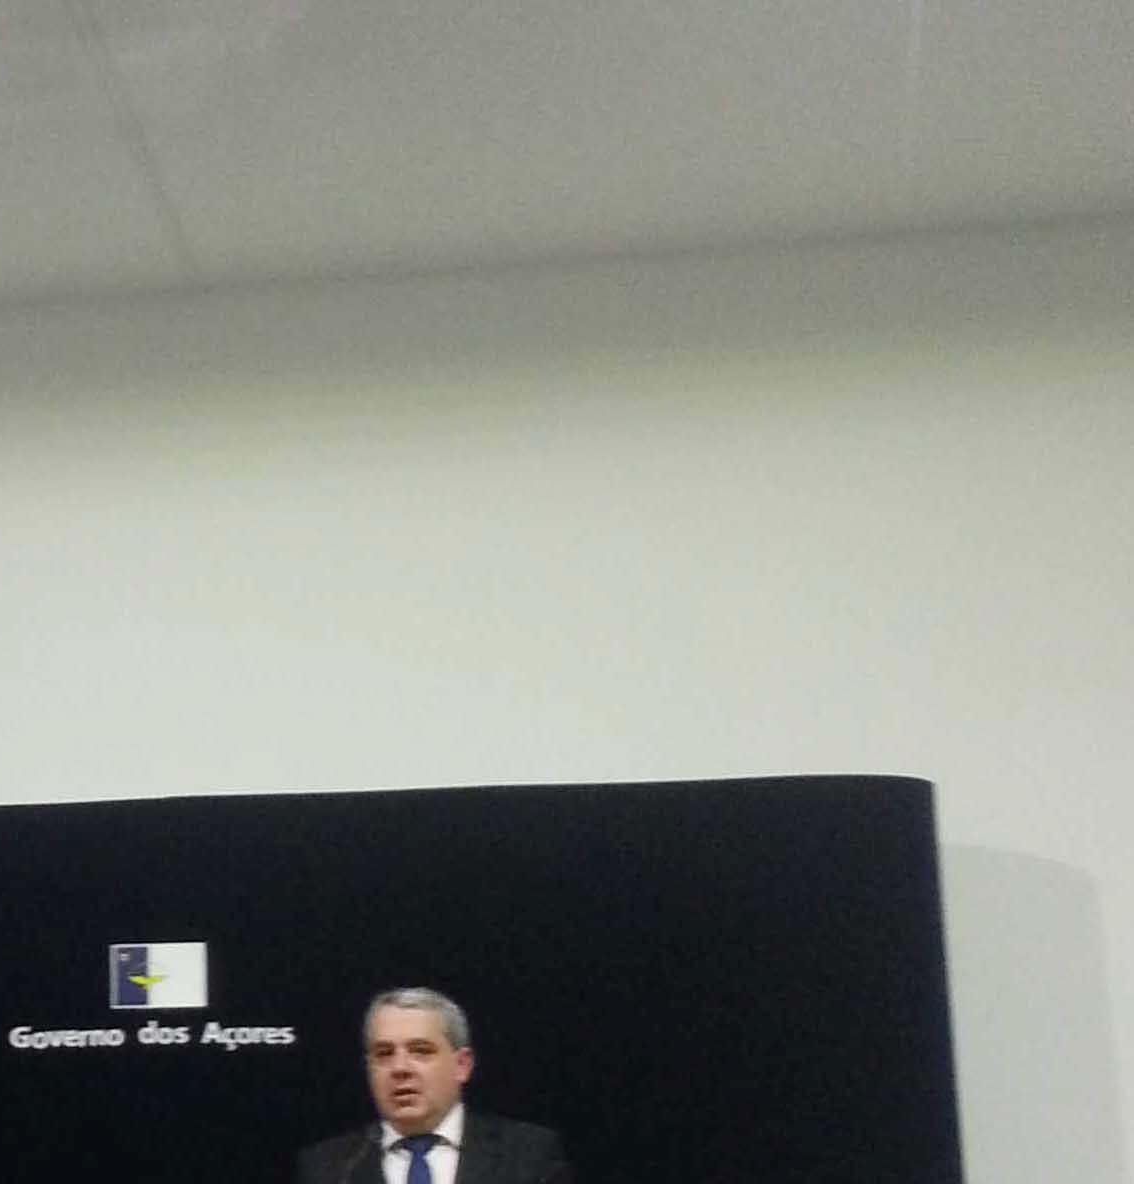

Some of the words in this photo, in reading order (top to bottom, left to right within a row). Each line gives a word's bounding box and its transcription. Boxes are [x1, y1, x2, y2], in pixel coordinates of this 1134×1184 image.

[8, 1026, 126, 1049] Governo
[137, 1020, 190, 1045] dos
[200, 1021, 296, 1051] Açores
